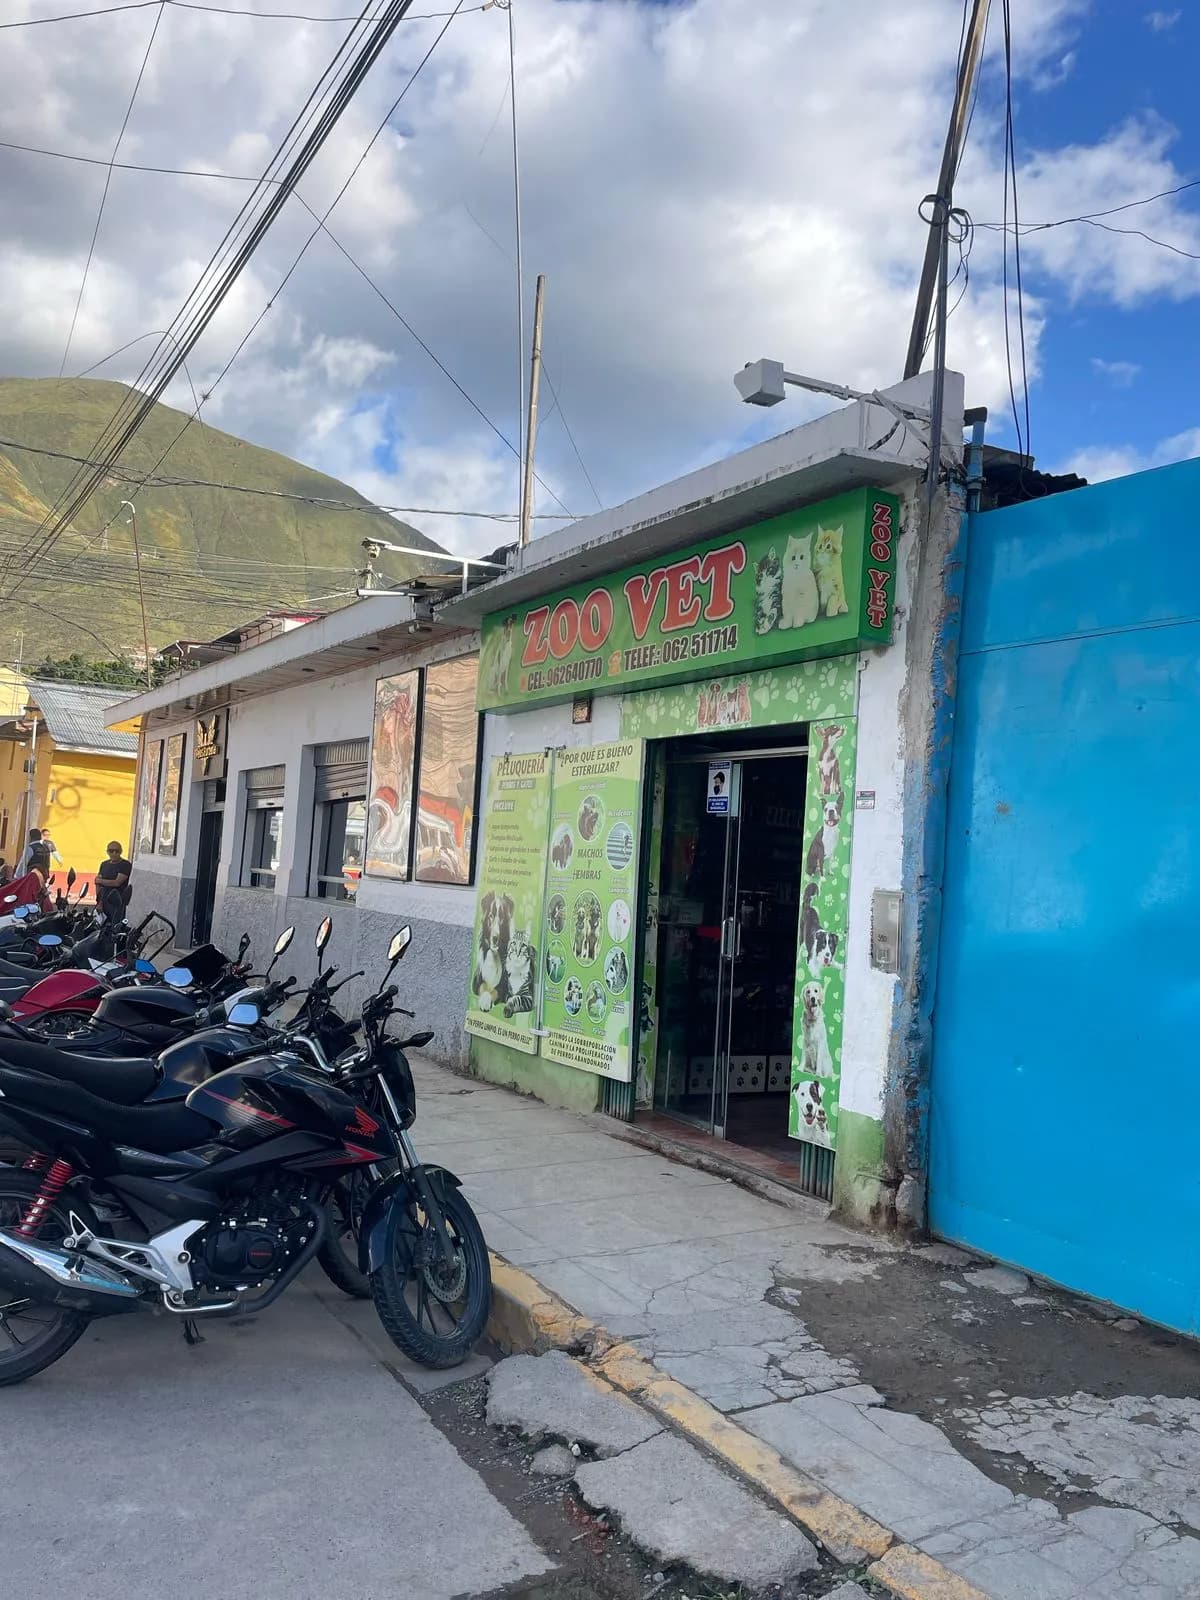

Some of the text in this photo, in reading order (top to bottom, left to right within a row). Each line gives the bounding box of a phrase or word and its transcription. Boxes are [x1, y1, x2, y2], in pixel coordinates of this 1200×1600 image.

[867, 503, 892, 627] ZOO VET
[521, 541, 747, 667] ZOO VET
[662, 637, 689, 663] 062
[691, 625, 737, 657] 511714
[581, 748, 596, 763] QUÉ
[597, 749, 605, 760] ES
[606, 745, 633, 758] BUENO
[497, 754, 545, 777] PELUQUERÍA
[572, 761, 619, 776] ESTERILIZAR?
[577, 848, 603, 858] MACHOS
[572, 870, 601, 880] HEMBRAS
[549, 1039, 565, 1049] CANINA
[557, 1049, 574, 1060] PERROS
[574, 1055, 610, 1070] ABANDONADOS
[345, 1125, 375, 1139] HONDA
